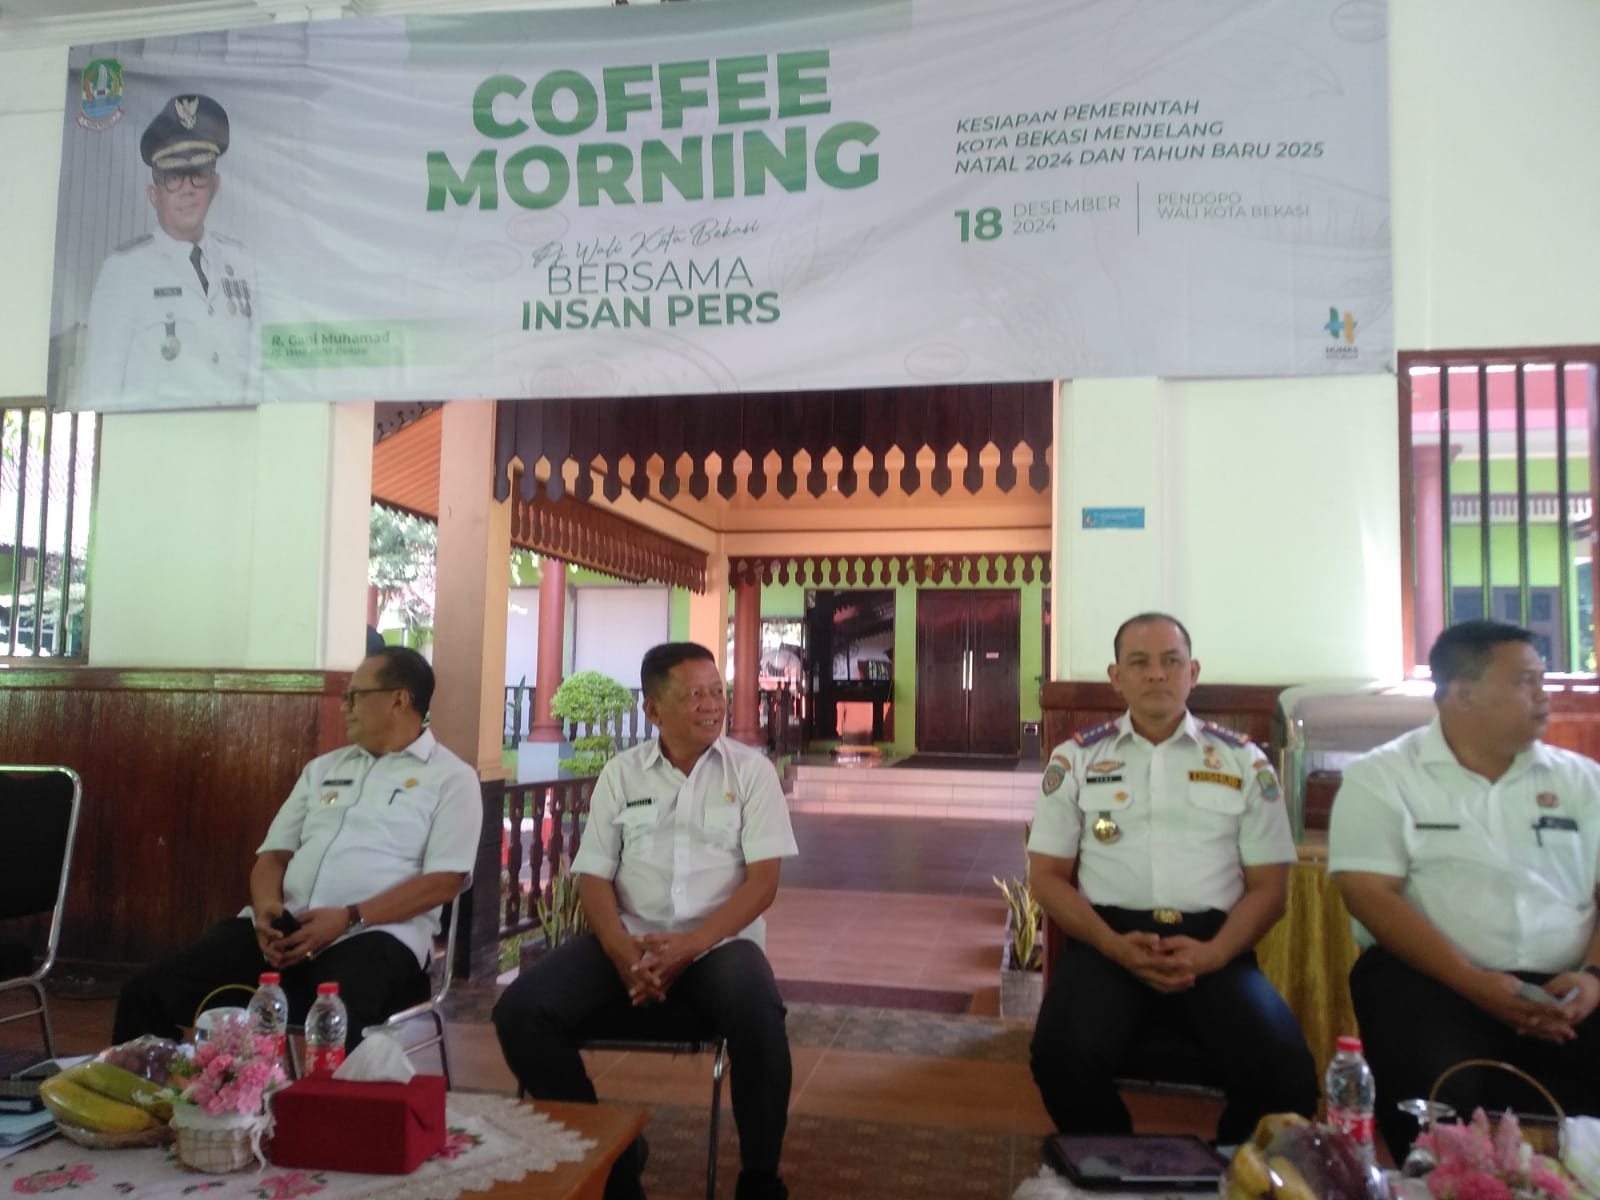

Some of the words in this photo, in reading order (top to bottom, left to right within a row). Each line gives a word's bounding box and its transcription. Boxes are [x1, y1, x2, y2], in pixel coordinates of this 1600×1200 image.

[472, 49, 832, 139] COFFEE
[956, 108, 1057, 134] KESIAPAN
[1063, 99, 1200, 122] PEMERINTAH
[955, 136, 1009, 155] KOTA
[1014, 127, 1088, 149] BEKASI
[1094, 120, 1224, 142] MENJELANG
[425, 121, 881, 212] MORNING
[954, 156, 1020, 175] NATAL
[1024, 152, 1074, 172] 2024
[1079, 146, 1126, 166] DAN
[1132, 143, 1206, 163] TAHUN
[1211, 141, 1270, 160] BARU
[1276, 140, 1325, 159] 2025
[1157, 191, 1242, 206] PENDOPO
[1157, 204, 1199, 220] WALI
[1203, 204, 1248, 219] KOTA
[1250, 203, 1311, 218] BEKASI
[953, 206, 1003, 242] 18
[1012, 194, 1121, 219] DESEMBER
[1012, 217, 1057, 235] 2024
[547, 256, 754, 297] BERSAMA
[521, 294, 652, 331] INSAN
[667, 290, 782, 328] PERS
[321, 329, 390, 345] Muhamad
